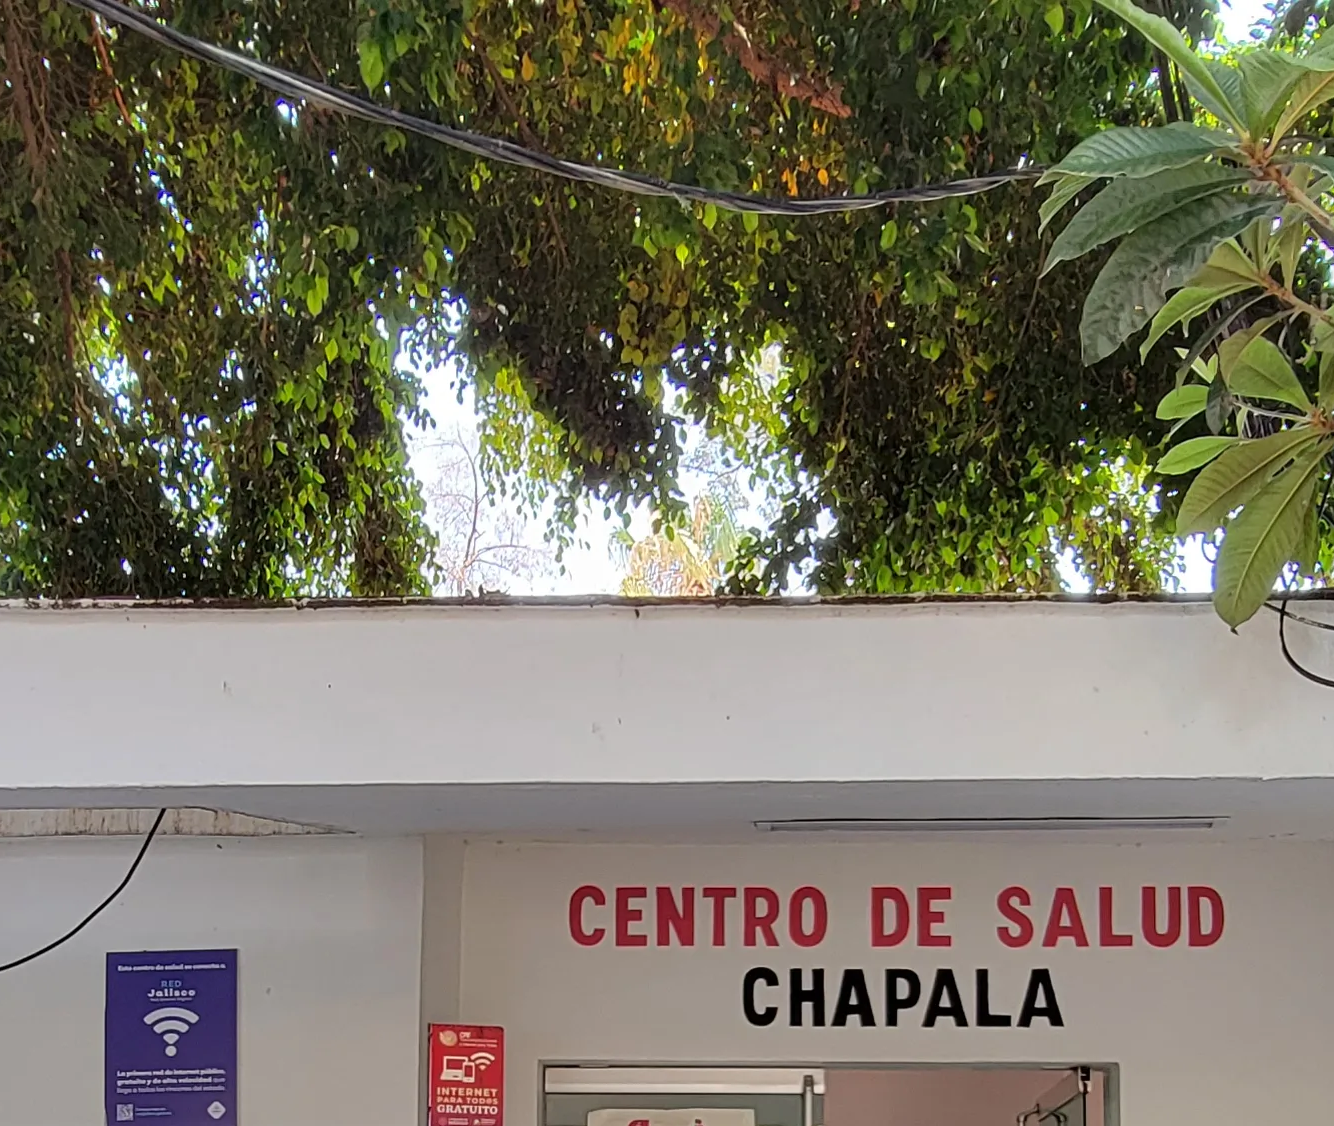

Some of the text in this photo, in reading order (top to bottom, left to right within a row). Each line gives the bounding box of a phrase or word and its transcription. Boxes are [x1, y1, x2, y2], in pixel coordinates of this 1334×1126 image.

[568, 886, 1224, 948] CENTRO DE SALUD
[147, 988, 195, 997] Jalisco
[743, 967, 1065, 1028] CHAPALA
[437, 1087, 497, 1097] INTERNET
[437, 1105, 498, 1114] GRATUITO
